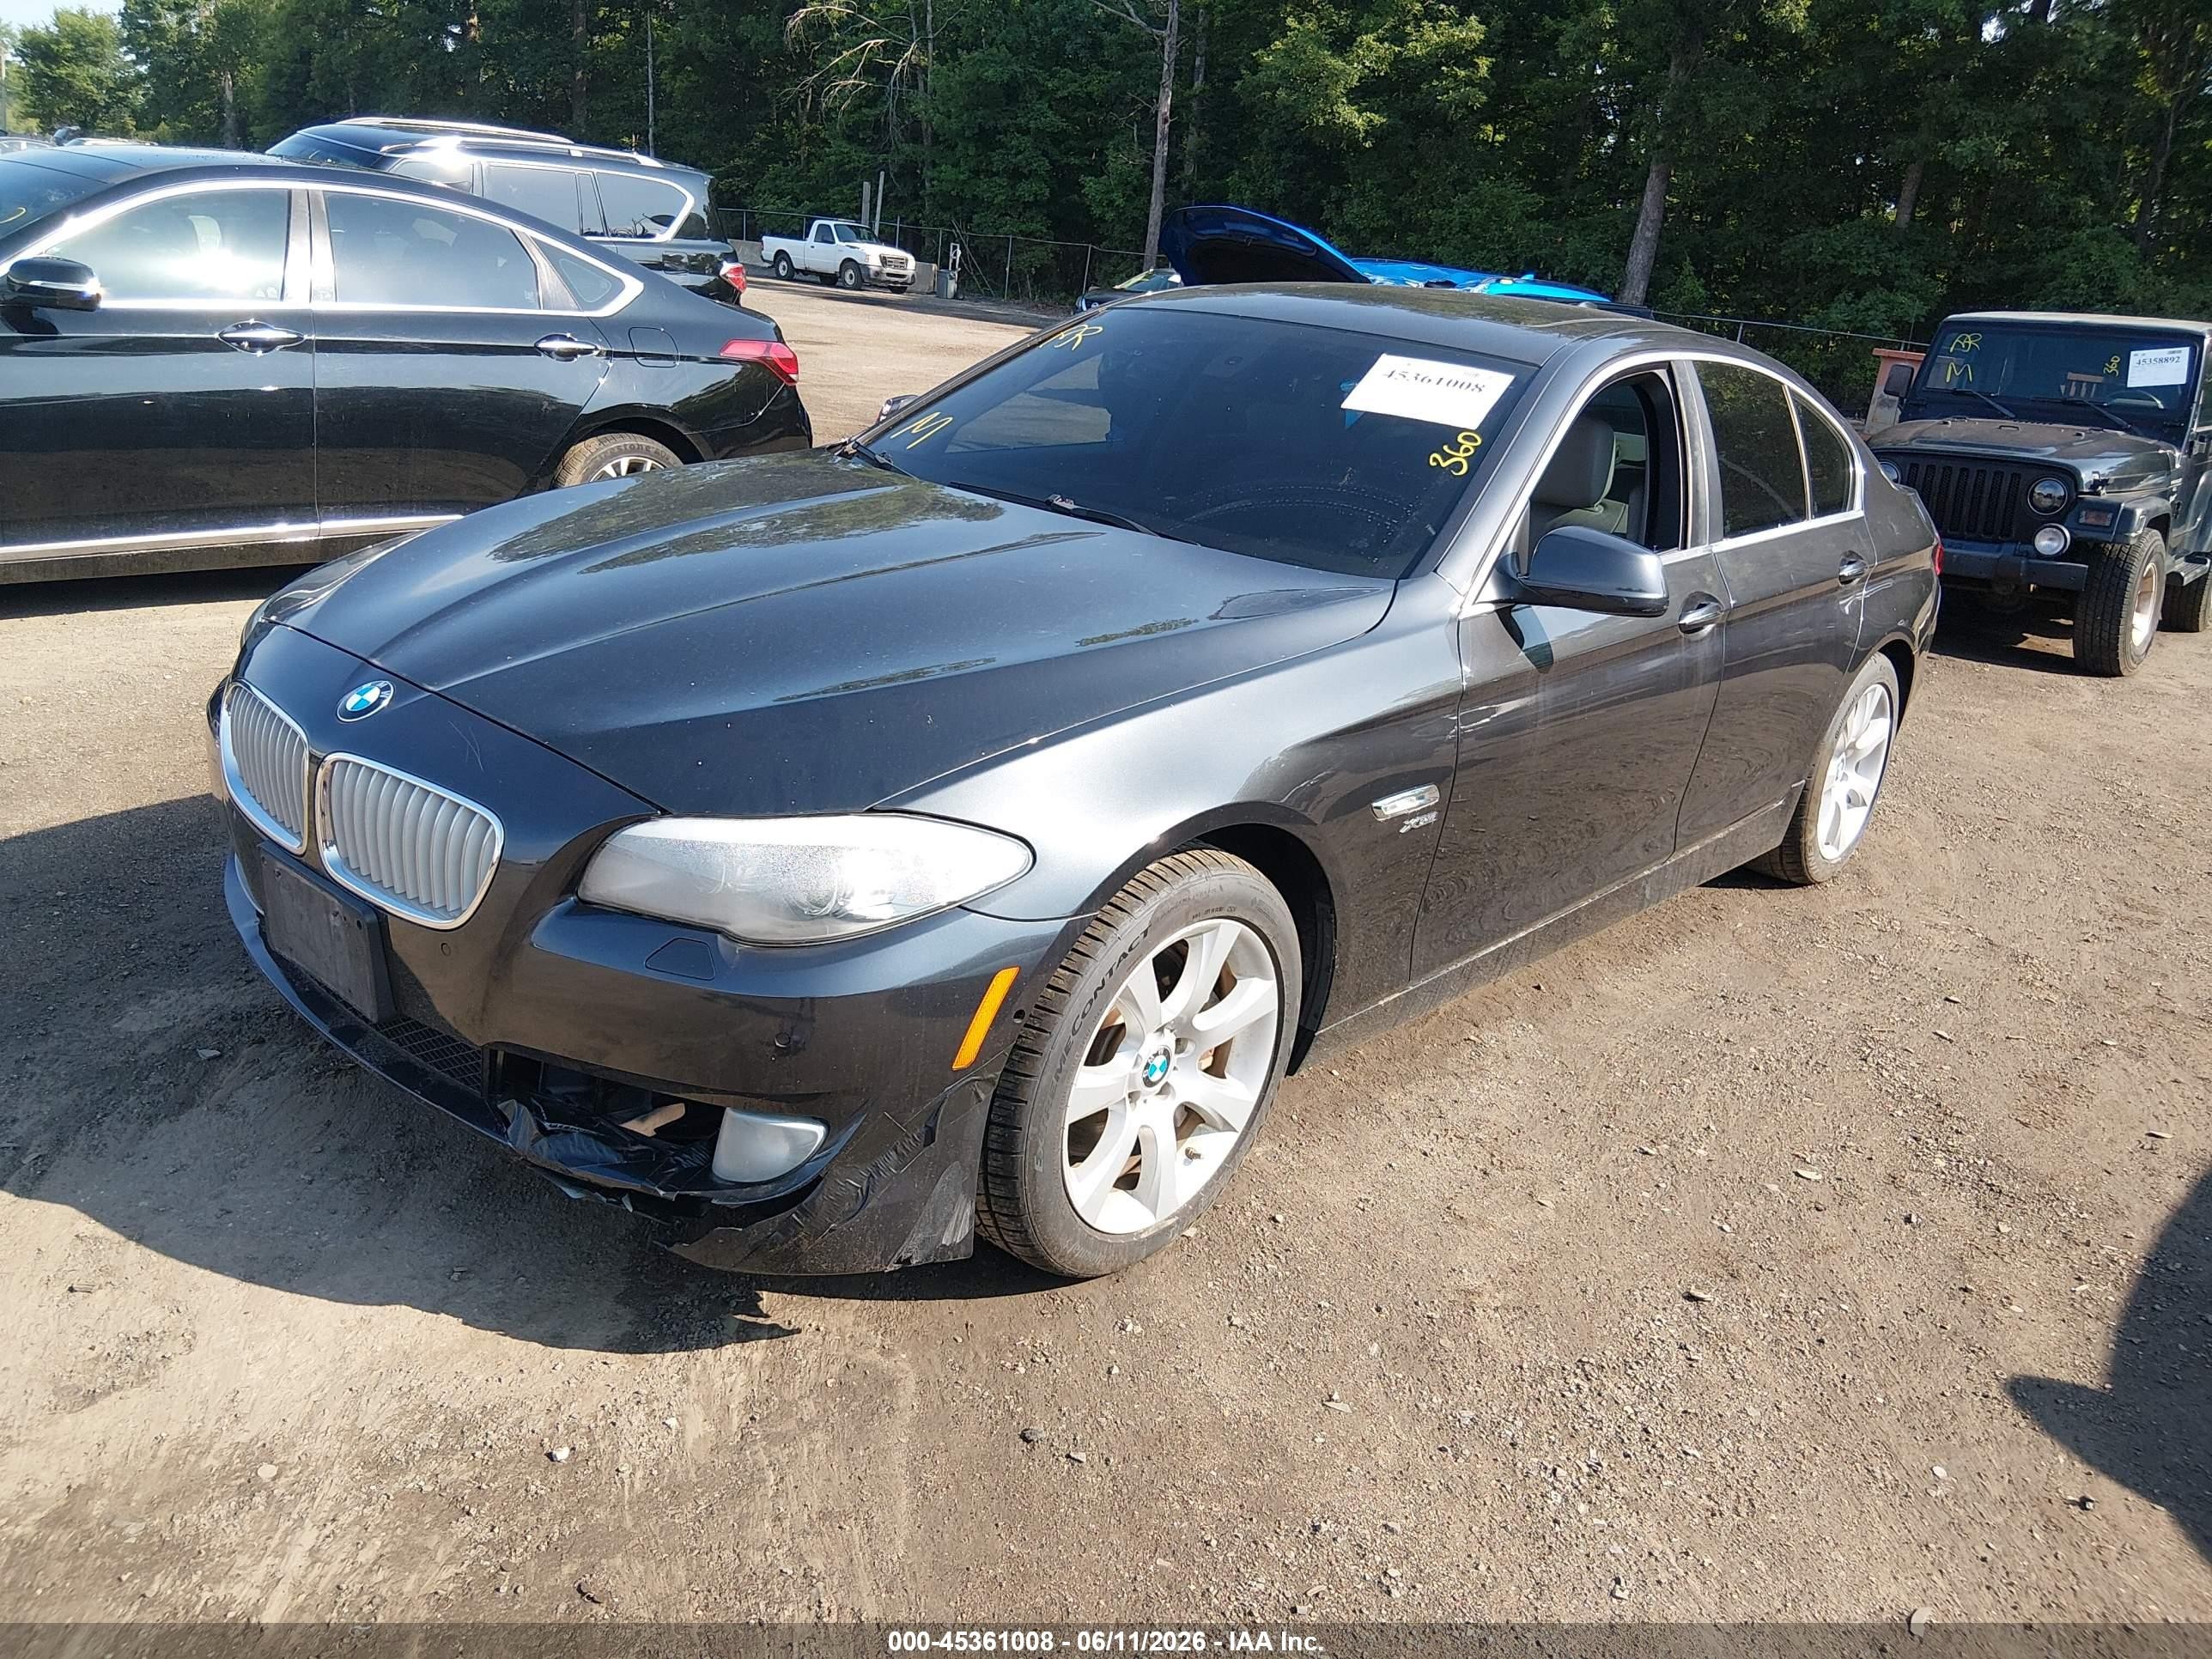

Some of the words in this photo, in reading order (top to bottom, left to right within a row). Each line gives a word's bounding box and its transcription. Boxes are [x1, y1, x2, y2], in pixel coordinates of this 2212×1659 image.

[1945, 362, 1972, 383] M
[2103, 355, 2121, 377] 360
[2136, 356, 2181, 367] 45358892
[1382, 368, 1486, 393] 45361008
[1429, 431, 1483, 476] 360
